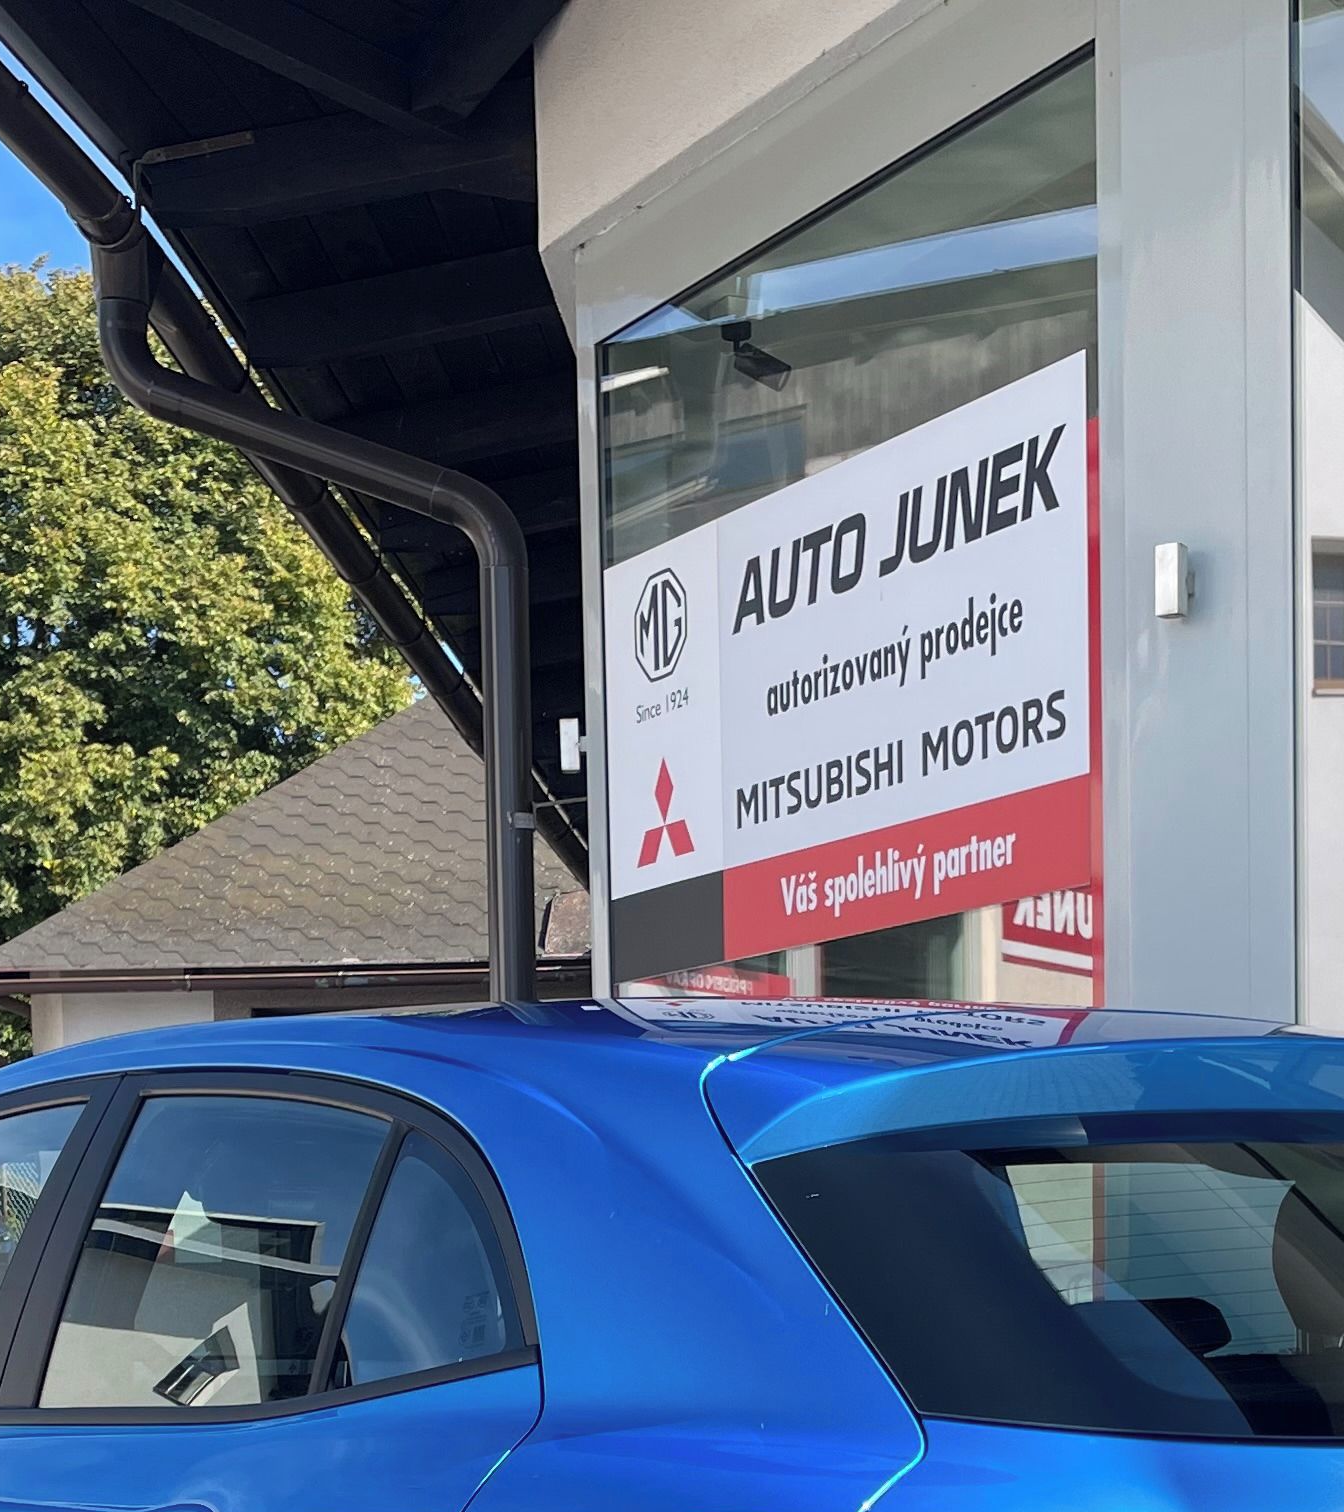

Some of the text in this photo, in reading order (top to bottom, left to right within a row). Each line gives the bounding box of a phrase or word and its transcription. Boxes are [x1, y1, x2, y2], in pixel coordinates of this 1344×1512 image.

[732, 423, 1067, 636] AUTO JUNEK
[638, 578, 683, 672] MG
[767, 592, 1023, 716] autorizovaný prodejce
[636, 687, 689, 724] Since 1924
[736, 689, 1066, 830] MITSUBISHI MOTORS
[780, 831, 1016, 918] Váš spolehlivý partner
